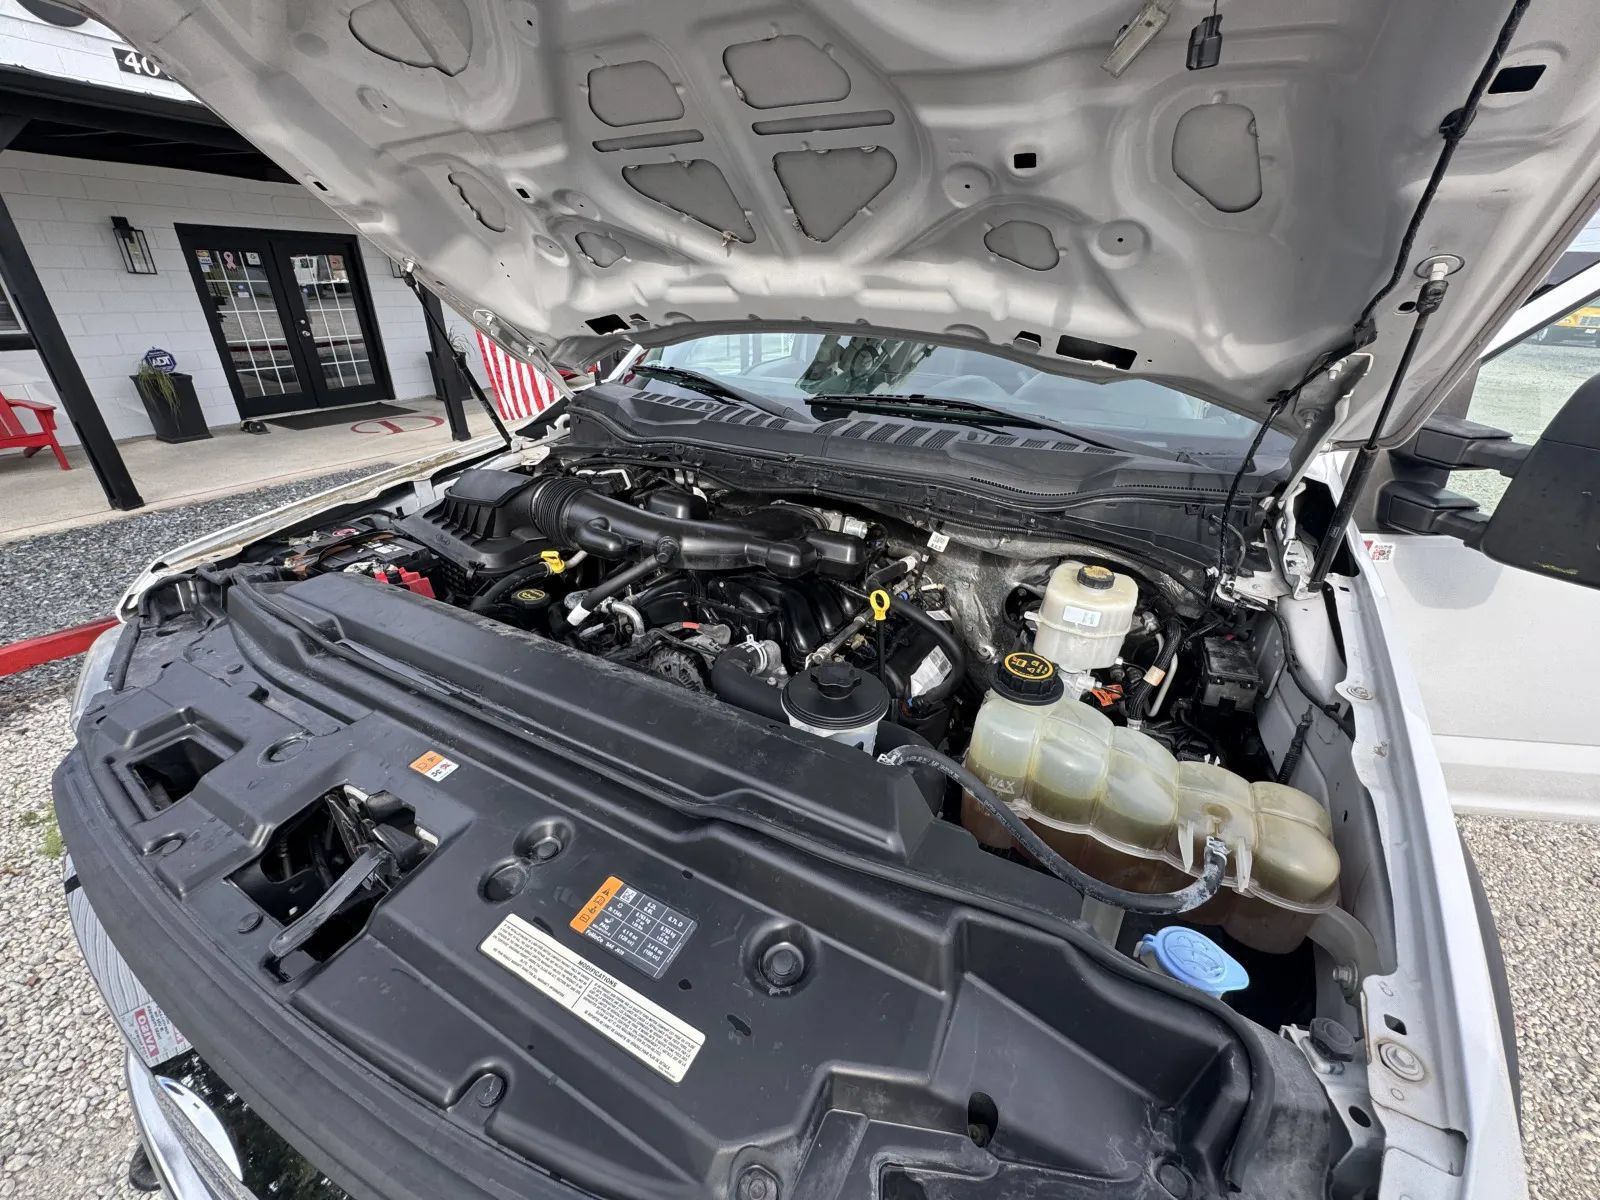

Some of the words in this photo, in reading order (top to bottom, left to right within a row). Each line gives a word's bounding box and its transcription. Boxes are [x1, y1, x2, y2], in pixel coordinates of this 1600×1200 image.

[152, 356, 171, 366] ADT
[988, 775, 1015, 793] MAX
[578, 960, 618, 988] MODIFICATIONS
